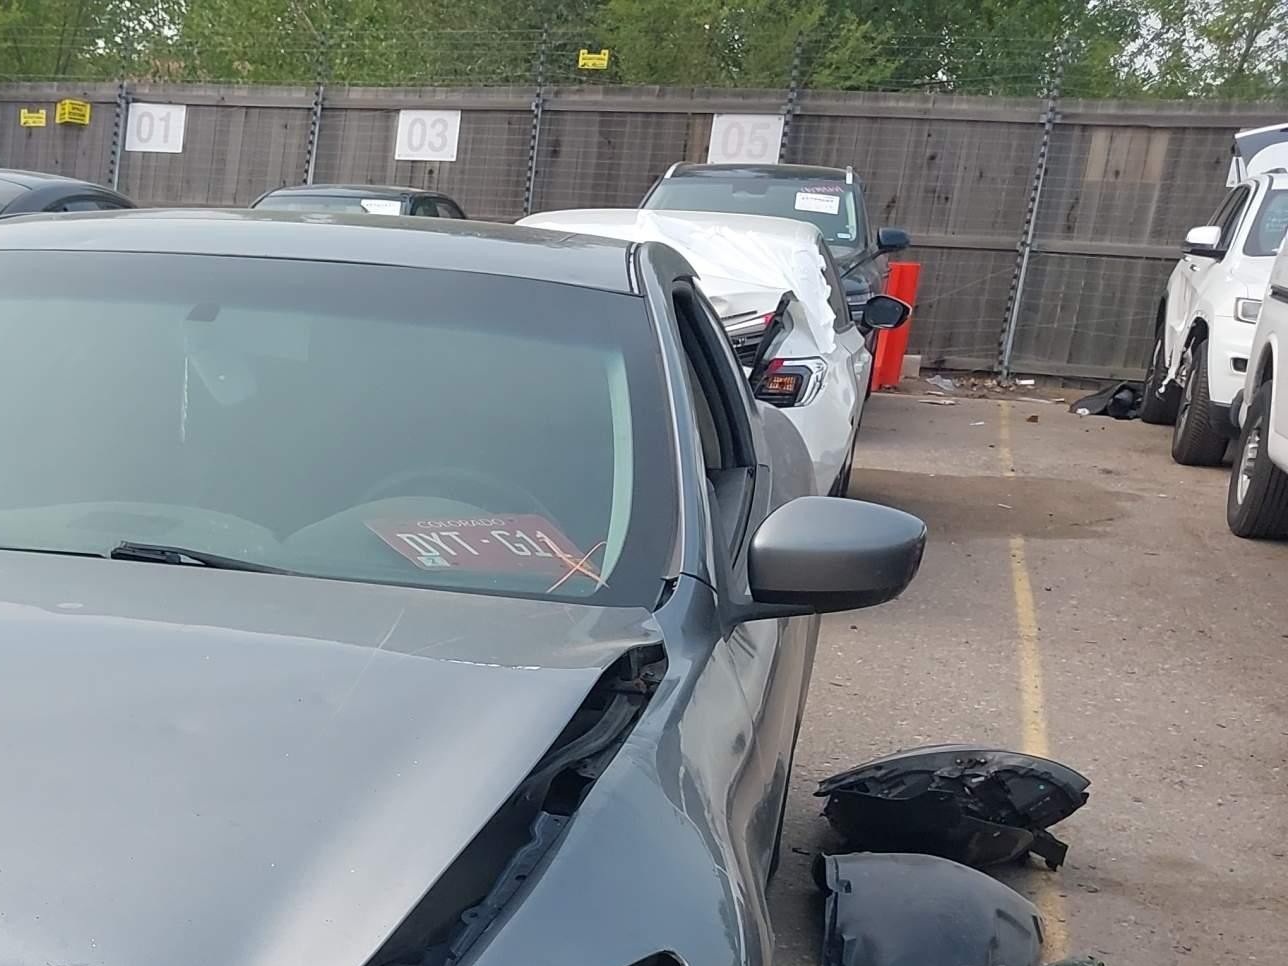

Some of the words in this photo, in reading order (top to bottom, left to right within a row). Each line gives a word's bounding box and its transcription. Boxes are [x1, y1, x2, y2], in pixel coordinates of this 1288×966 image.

[136, 111, 172, 145] 01
[407, 117, 450, 153] 03
[720, 121, 771, 160] 05
[416, 518, 505, 529] COLORADO
[396, 530, 480, 556] DYT
